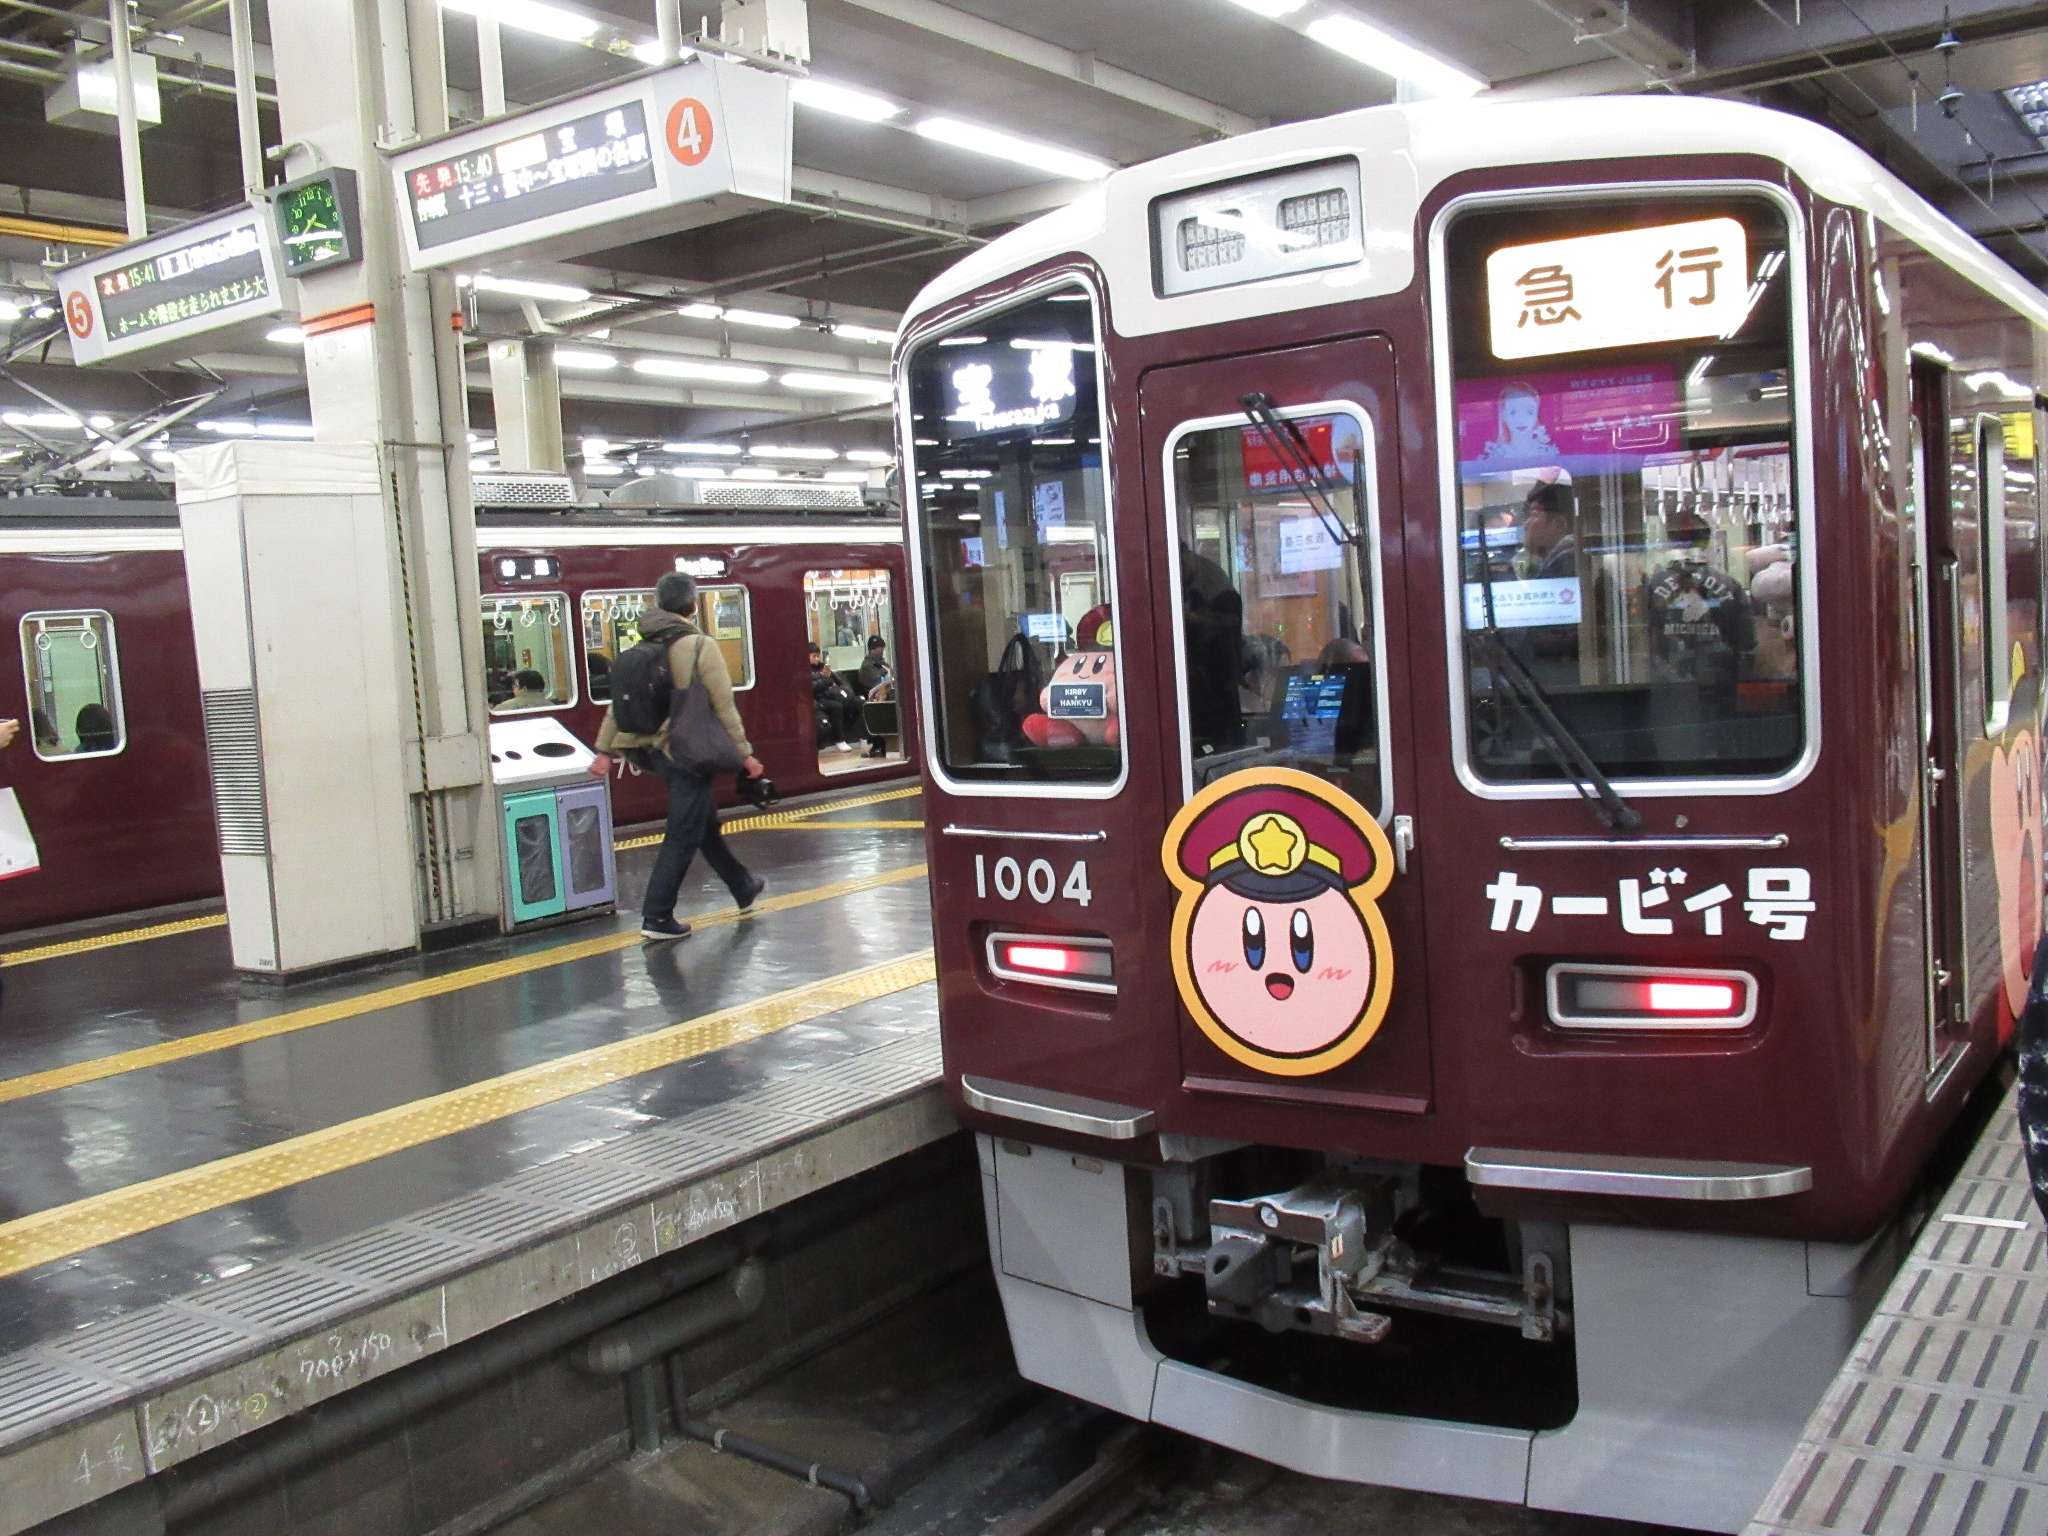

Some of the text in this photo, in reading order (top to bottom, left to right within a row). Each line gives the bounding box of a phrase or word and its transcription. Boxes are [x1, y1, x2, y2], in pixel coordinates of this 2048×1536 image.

[677, 106, 702, 154] 4
[454, 152, 493, 184] 15:40
[129, 262, 156, 288] 15:41
[1514, 246, 1724, 328] 急行
[76, 297, 89, 332] 5
[1060, 699, 1093, 707] HANKYU
[1064, 688, 1088, 696] KIRBY
[975, 854, 1092, 907] 1004
[1486, 867, 1816, 940] カービィ号
